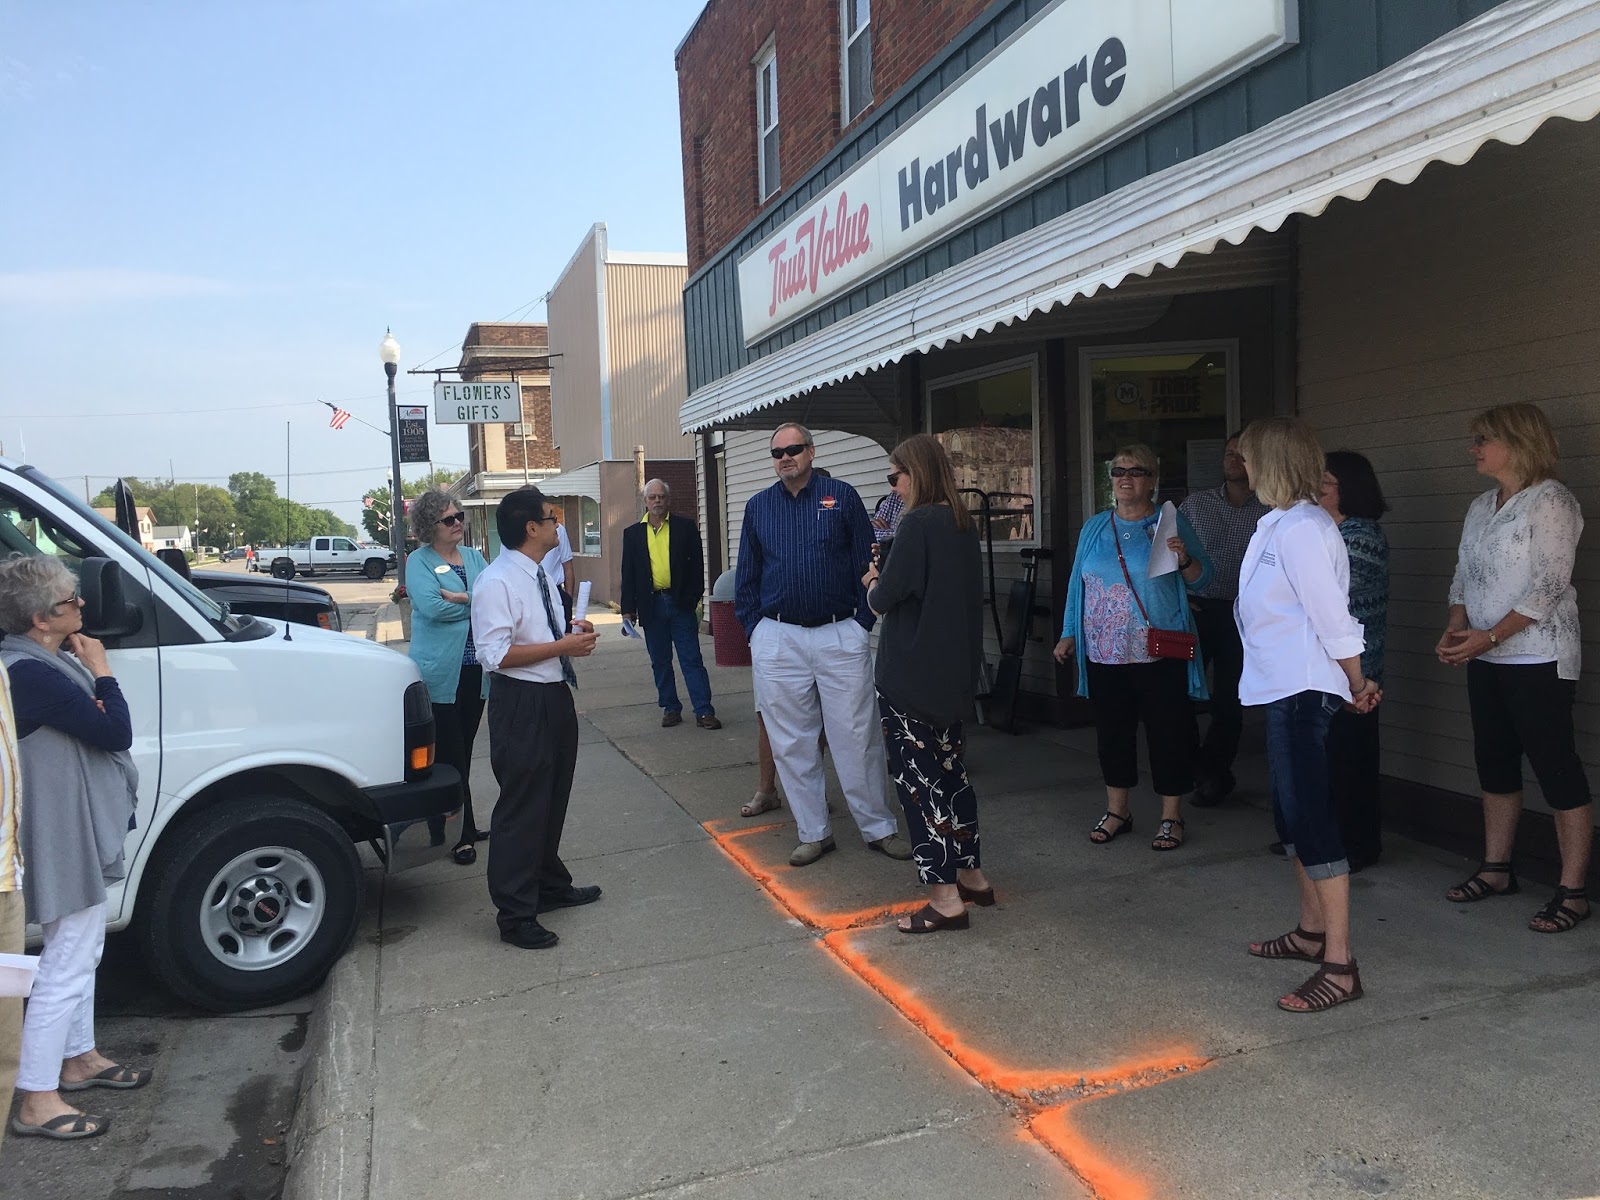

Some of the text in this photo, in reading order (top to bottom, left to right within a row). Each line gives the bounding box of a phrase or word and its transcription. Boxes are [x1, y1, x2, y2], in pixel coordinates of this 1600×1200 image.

[768, 37, 1127, 317] True Value Hardware
[443, 385, 511, 401] FLOWERS
[457, 405, 499, 420] GIFTS
[403, 427, 425, 436] 1905
